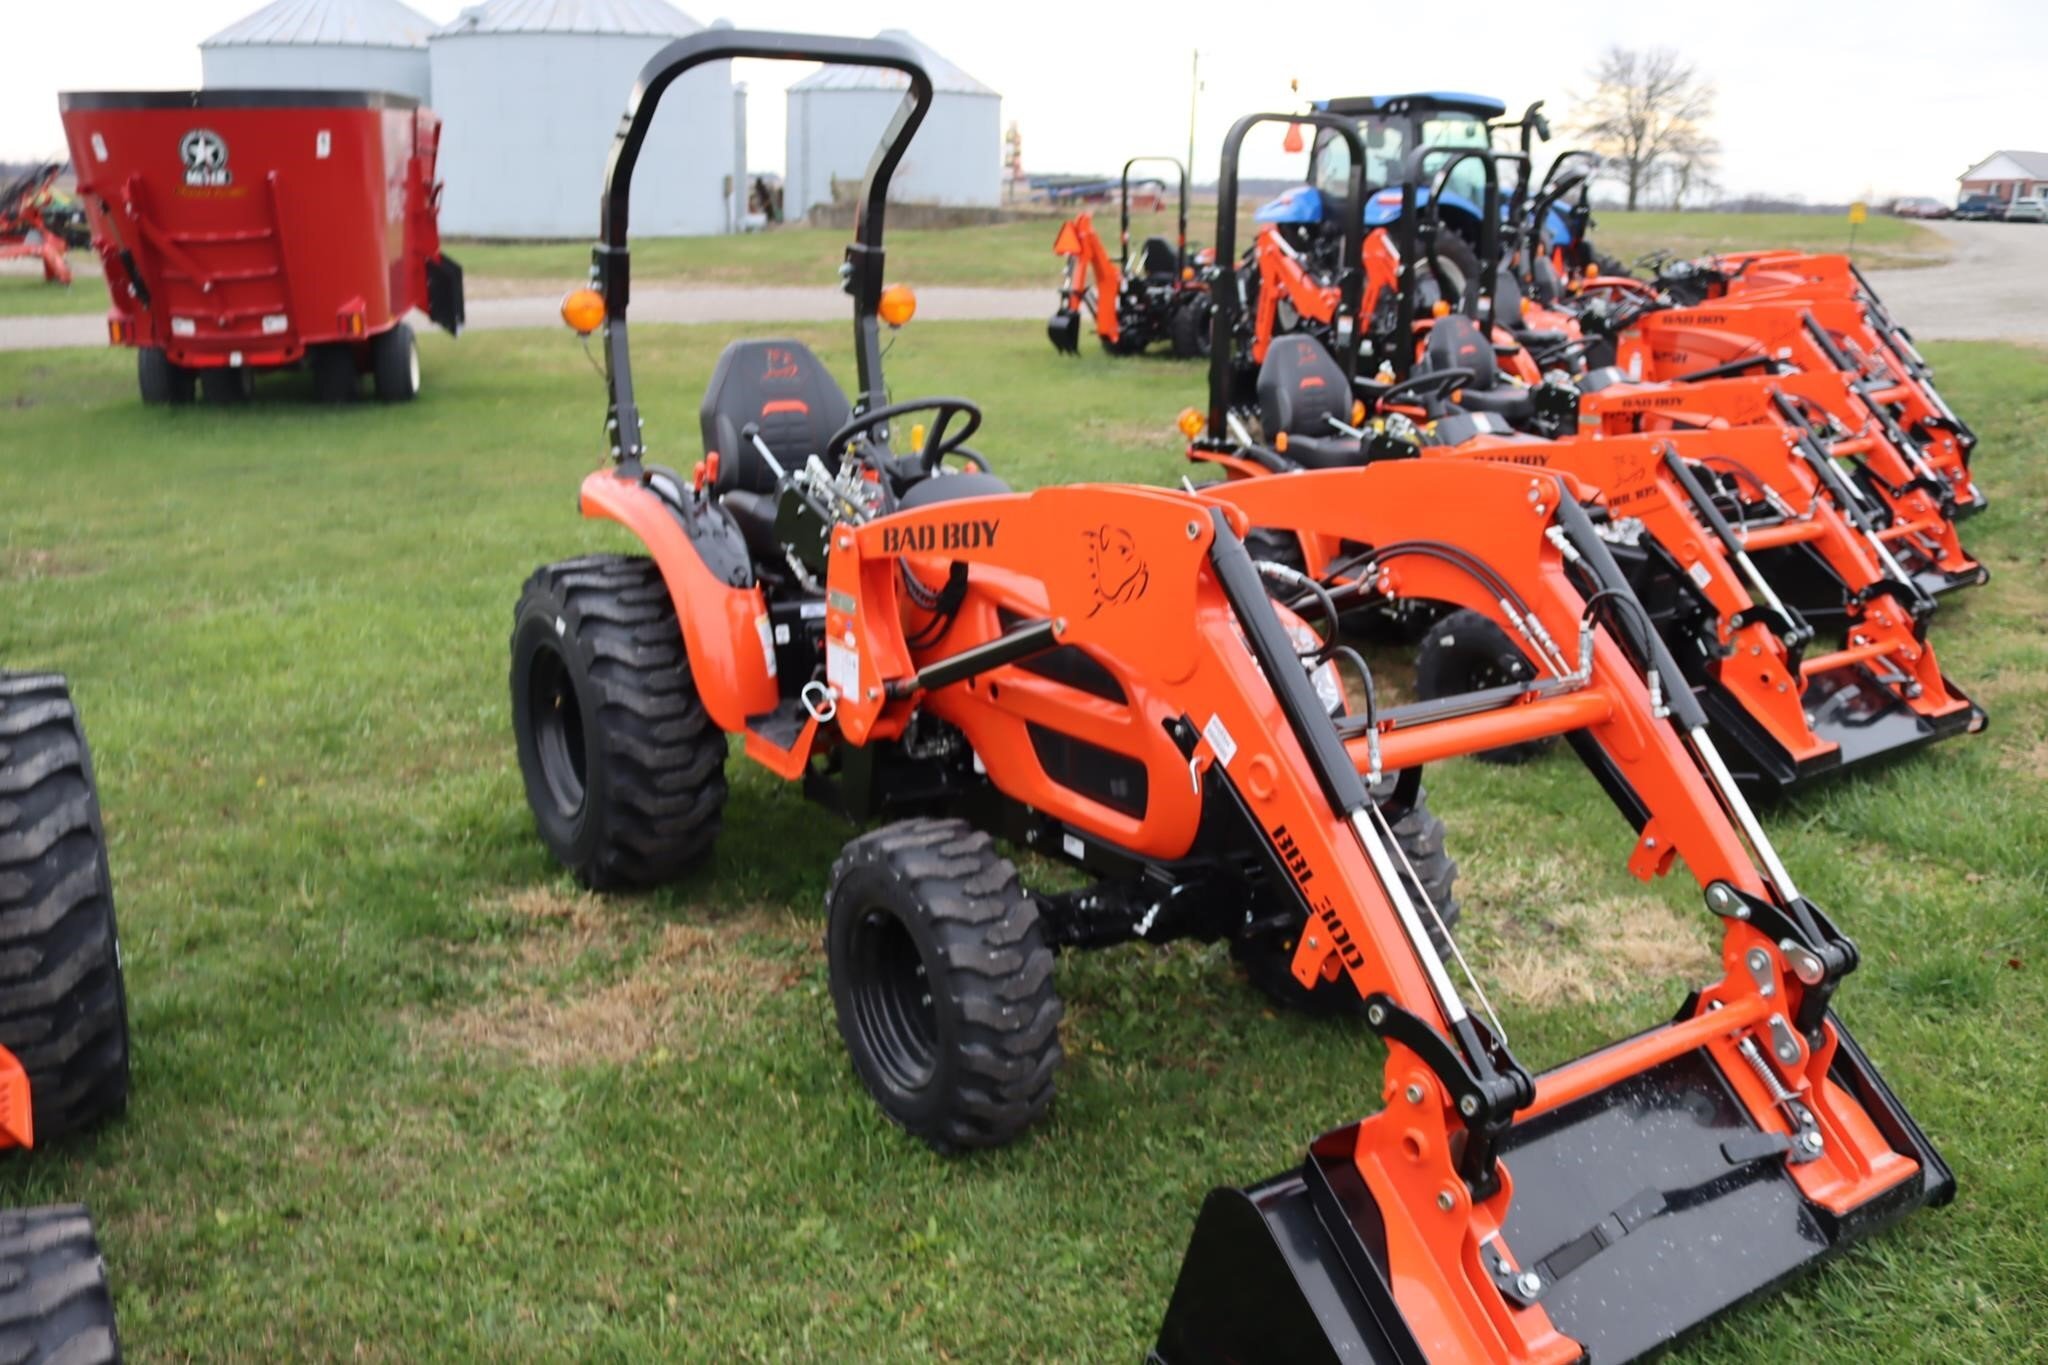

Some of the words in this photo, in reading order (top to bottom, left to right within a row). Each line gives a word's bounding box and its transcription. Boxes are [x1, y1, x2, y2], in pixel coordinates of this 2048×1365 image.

[883, 524, 936, 552] BAD
[943, 519, 1000, 549] BOY
[1272, 824, 1314, 895] BBL
[1314, 895, 1365, 970] 300
